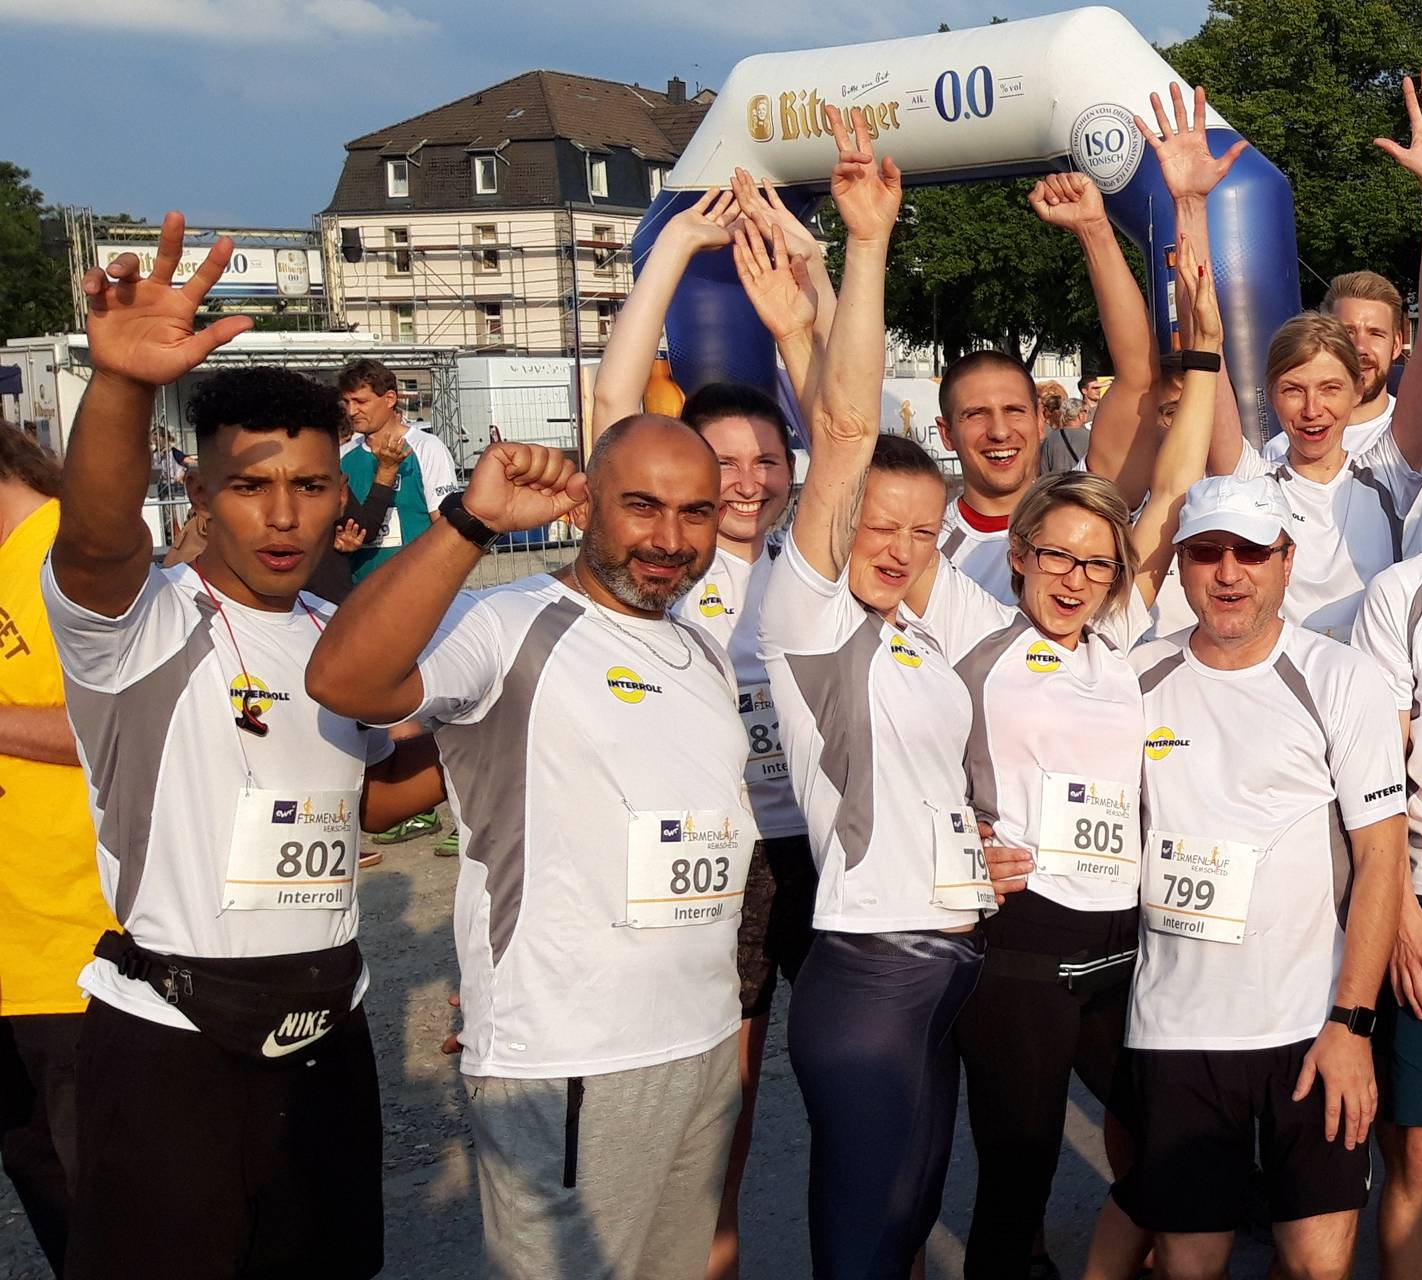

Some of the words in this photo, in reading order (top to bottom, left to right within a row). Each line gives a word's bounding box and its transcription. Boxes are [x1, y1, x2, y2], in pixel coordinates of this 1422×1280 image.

[934, 65, 994, 123] 0.0
[1085, 128, 1124, 157] ISO
[1088, 153, 1124, 167] TONISCH
[107, 251, 199, 276] itger
[608, 679, 662, 693] INTERROLL
[1145, 740, 1190, 748] INTERROLL
[1364, 784, 1403, 802] INTERR
[1086, 795, 1131, 811] FIRMENLAUF
[297, 811, 351, 824] FIRMENLAUF
[683, 830, 739, 842] FIRMENLAUF
[1074, 818, 1124, 854] 805
[276, 840, 346, 878] 802
[1173, 851, 1230, 868] FIRMENLAUF
[670, 856, 729, 894] 803
[1077, 860, 1120, 876] Interroll
[278, 889, 343, 903] Interroll
[1163, 874, 1215, 911] 799
[675, 904, 723, 920] Interroll
[1163, 916, 1205, 934] Interroll
[277, 1010, 330, 1037] NIKE
